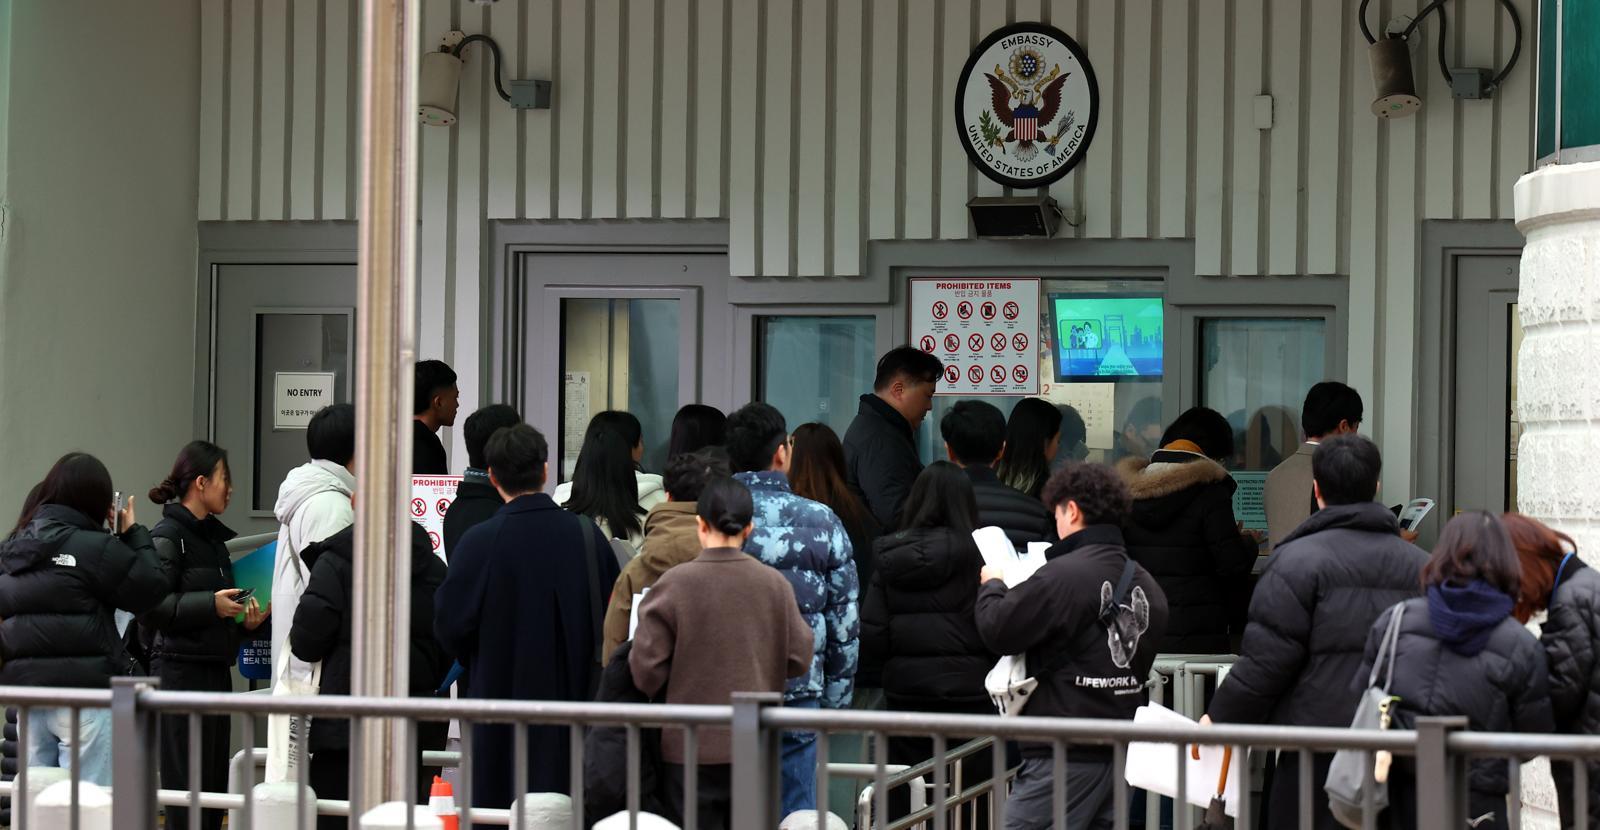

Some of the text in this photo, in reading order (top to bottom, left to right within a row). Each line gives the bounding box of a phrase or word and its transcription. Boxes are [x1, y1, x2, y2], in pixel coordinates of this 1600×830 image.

[1001, 35, 1054, 50] EMBASSY
[968, 123, 1086, 177] UNITED STATES OF AMERICA
[936, 282, 1012, 290] PROHIBITED ITEMS
[287, 388, 322, 396] NO ENTRY
[1042, 383, 1050, 395] 2
[413, 479, 458, 487] PROHIBITE
[1075, 676, 1130, 688] LIFEWORK
